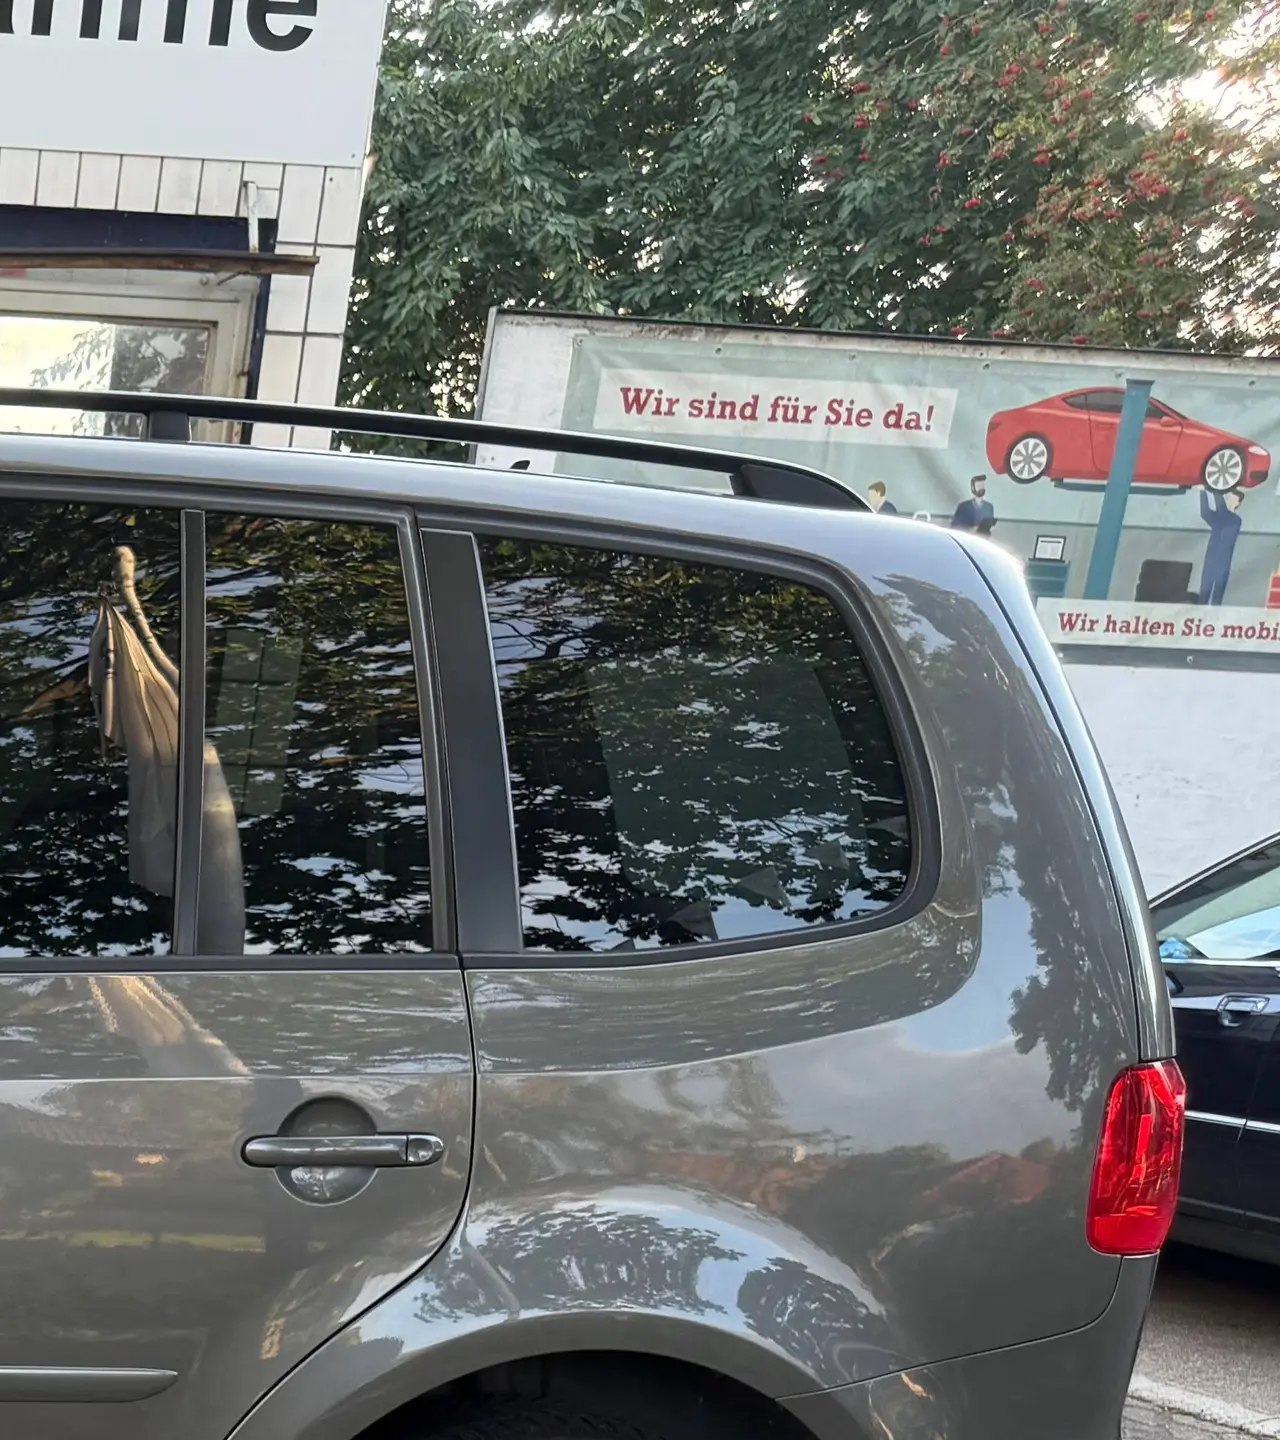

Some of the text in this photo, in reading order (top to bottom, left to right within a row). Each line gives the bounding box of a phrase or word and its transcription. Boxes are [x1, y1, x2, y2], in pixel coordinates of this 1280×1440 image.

[620, 386, 935, 431] Wir sind für Sie da!
[1057, 611, 1100, 633] Wir
[1103, 614, 1175, 636] halten
[1181, 618, 1215, 638] Sie
